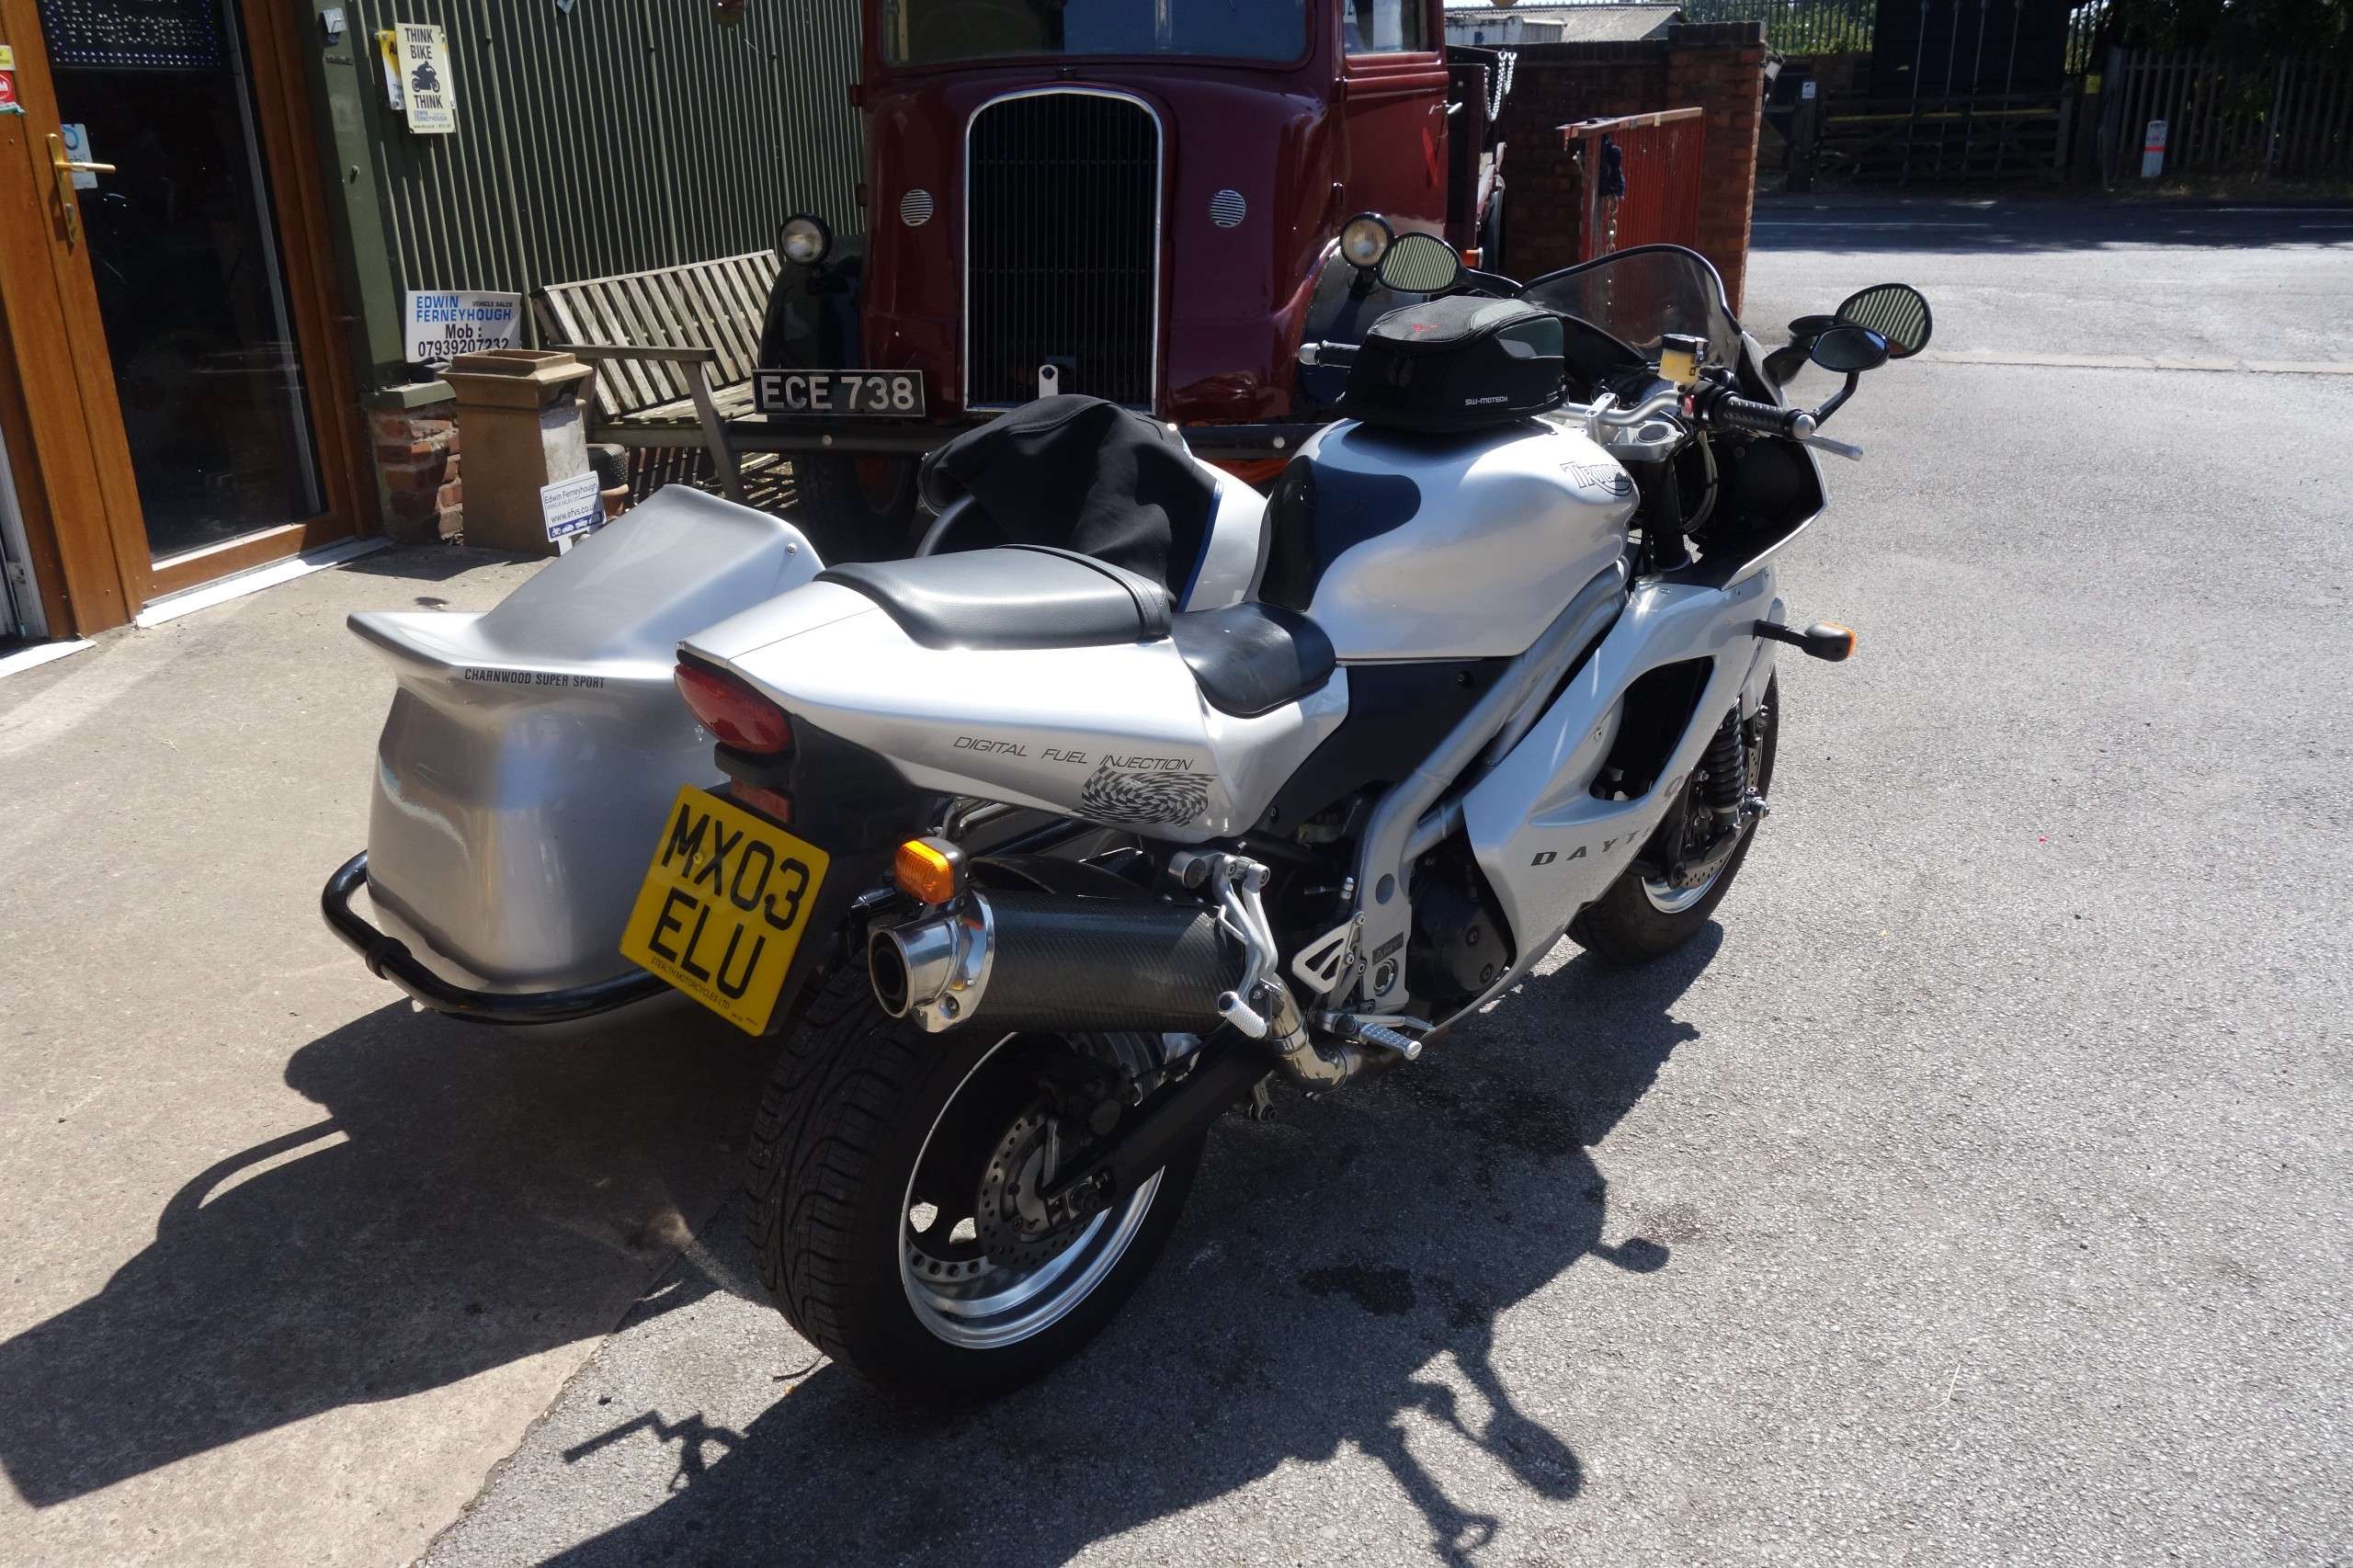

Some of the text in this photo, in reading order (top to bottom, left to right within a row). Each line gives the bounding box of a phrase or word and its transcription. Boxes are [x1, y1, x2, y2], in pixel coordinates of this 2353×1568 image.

[404, 28, 434, 43] THINK
[410, 45, 433, 60] BIKE
[414, 94, 443, 109] THINK
[416, 295, 459, 309] EDWIN
[416, 308, 511, 323] FERNEYHOUGH
[445, 324, 473, 339] Mob
[760, 375, 915, 411] ECE 738
[1464, 395, 1508, 405] SW-MOTECH
[544, 494, 563, 505] Edwin
[464, 668, 606, 688] CHARNWOOD SUPER SPORT
[953, 736, 1194, 771] DIGITAL FUEL INJECTION
[661, 803, 811, 931] MX03
[648, 886, 766, 1000] ELU
[651, 957, 730, 1009] STEALTH MOTORCYCLES LTD
